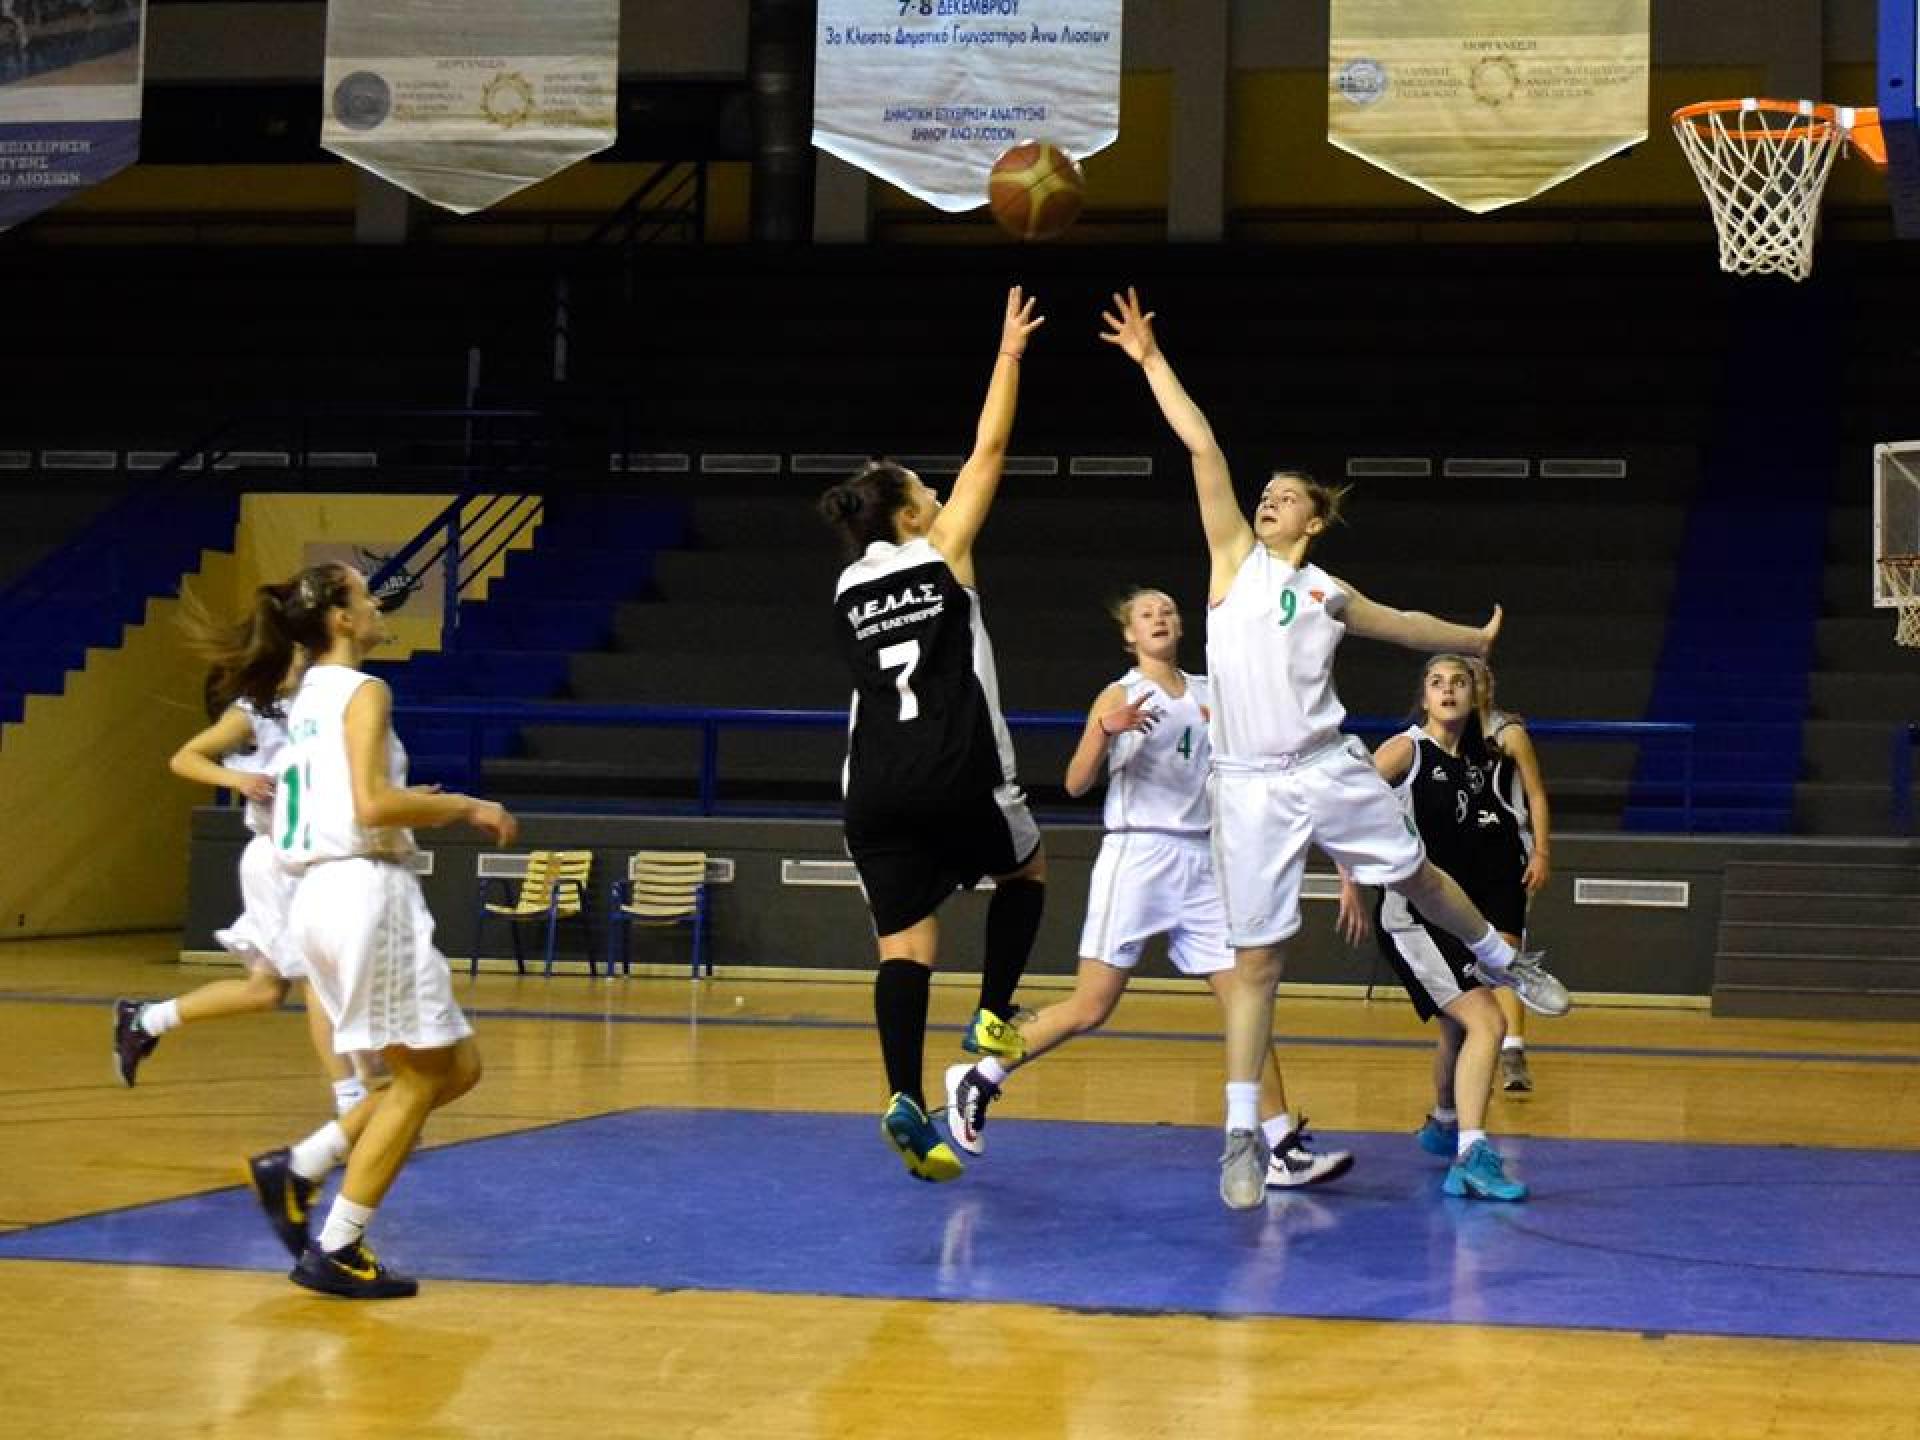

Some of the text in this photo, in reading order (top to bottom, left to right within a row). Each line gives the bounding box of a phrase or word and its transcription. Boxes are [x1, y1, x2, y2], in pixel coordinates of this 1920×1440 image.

[1278, 590, 1297, 627] 9
[879, 639, 920, 721] 7
[1177, 726, 1192, 759] 4
[1456, 789, 1468, 824] 8
